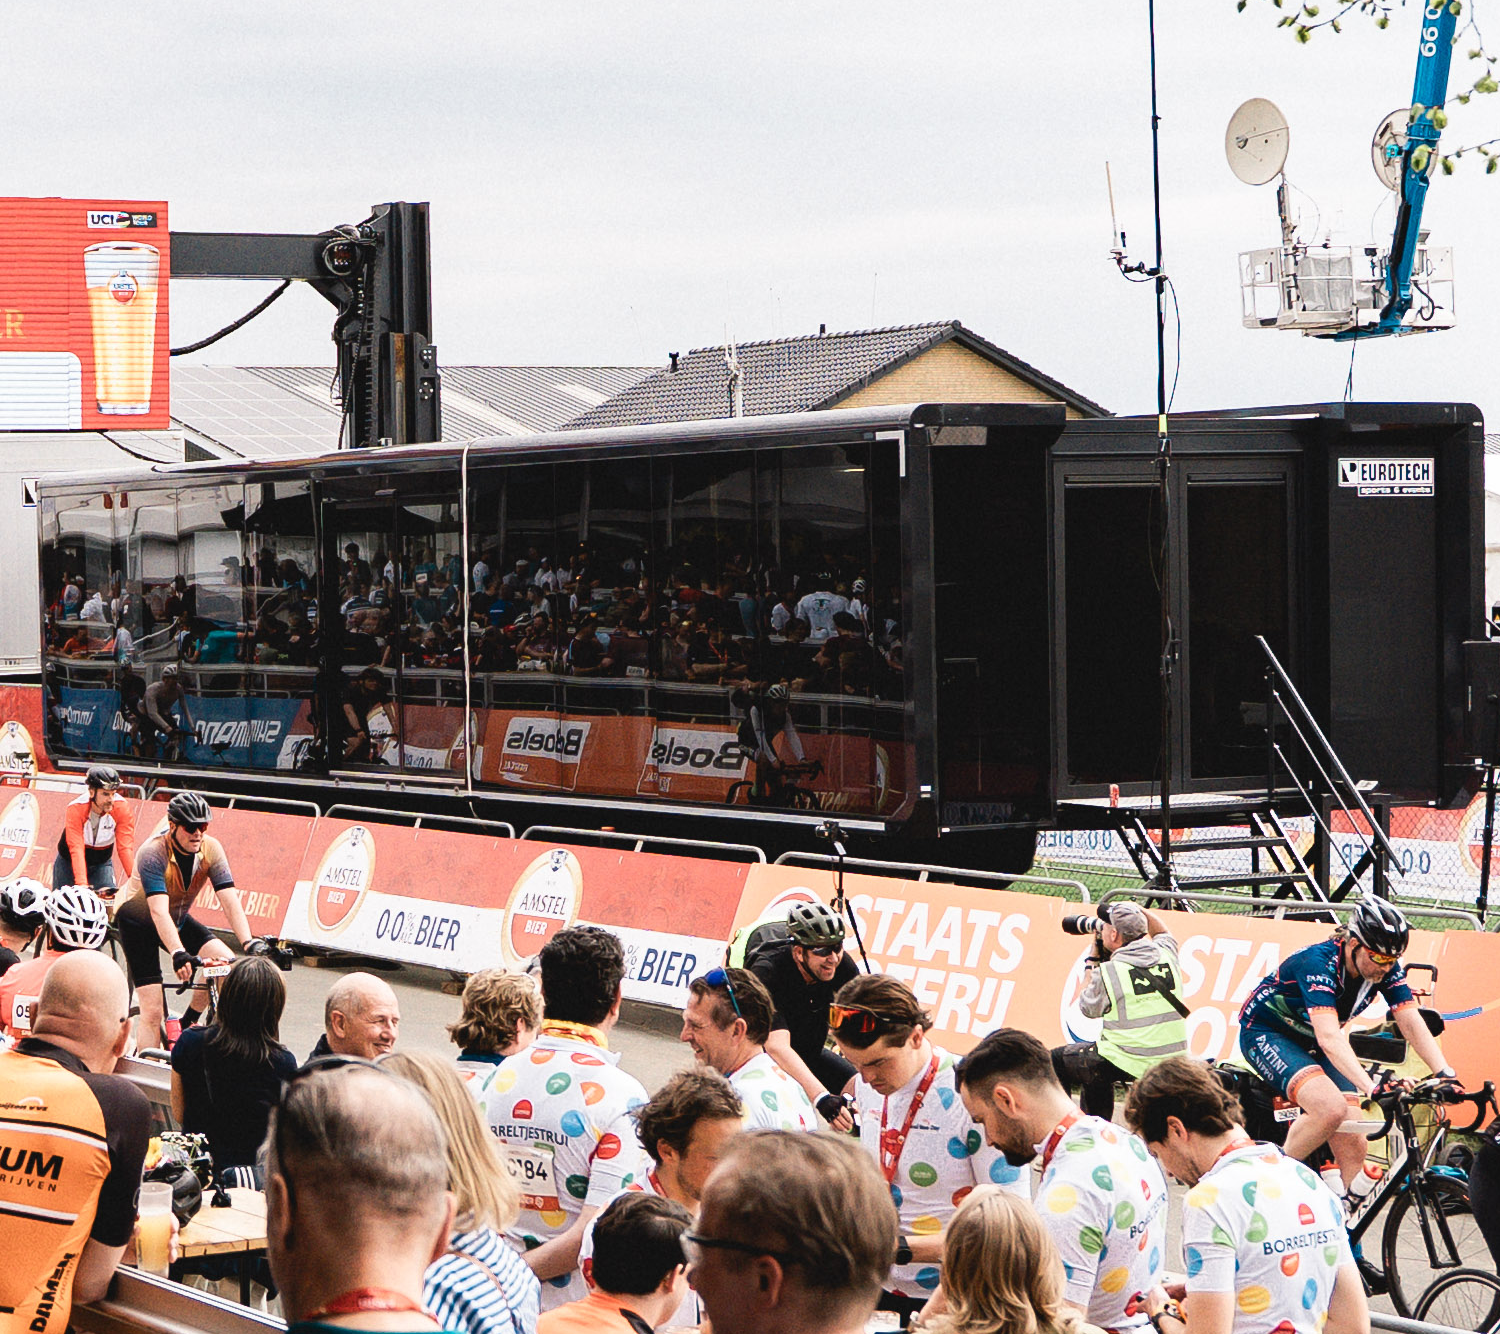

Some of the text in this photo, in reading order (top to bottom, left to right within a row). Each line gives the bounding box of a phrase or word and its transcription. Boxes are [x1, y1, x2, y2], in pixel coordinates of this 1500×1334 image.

[91, 213, 115, 224] UCI
[1361, 463, 1430, 481] EUROTECH
[325, 866, 363, 887] AMSTEL
[246, 890, 281, 919] BIER
[327, 890, 346, 905] BIER
[519, 892, 567, 916] AMSTEL
[414, 915, 462, 952] BIER
[525, 919, 548, 936] BIER
[848, 893, 1031, 973] STAATS
[637, 947, 698, 988] BIER
[1178, 931, 1281, 1007] STA
[1254, 1033, 1289, 1076] FANTINI
[28, 1252, 76, 1333] DAMEN
